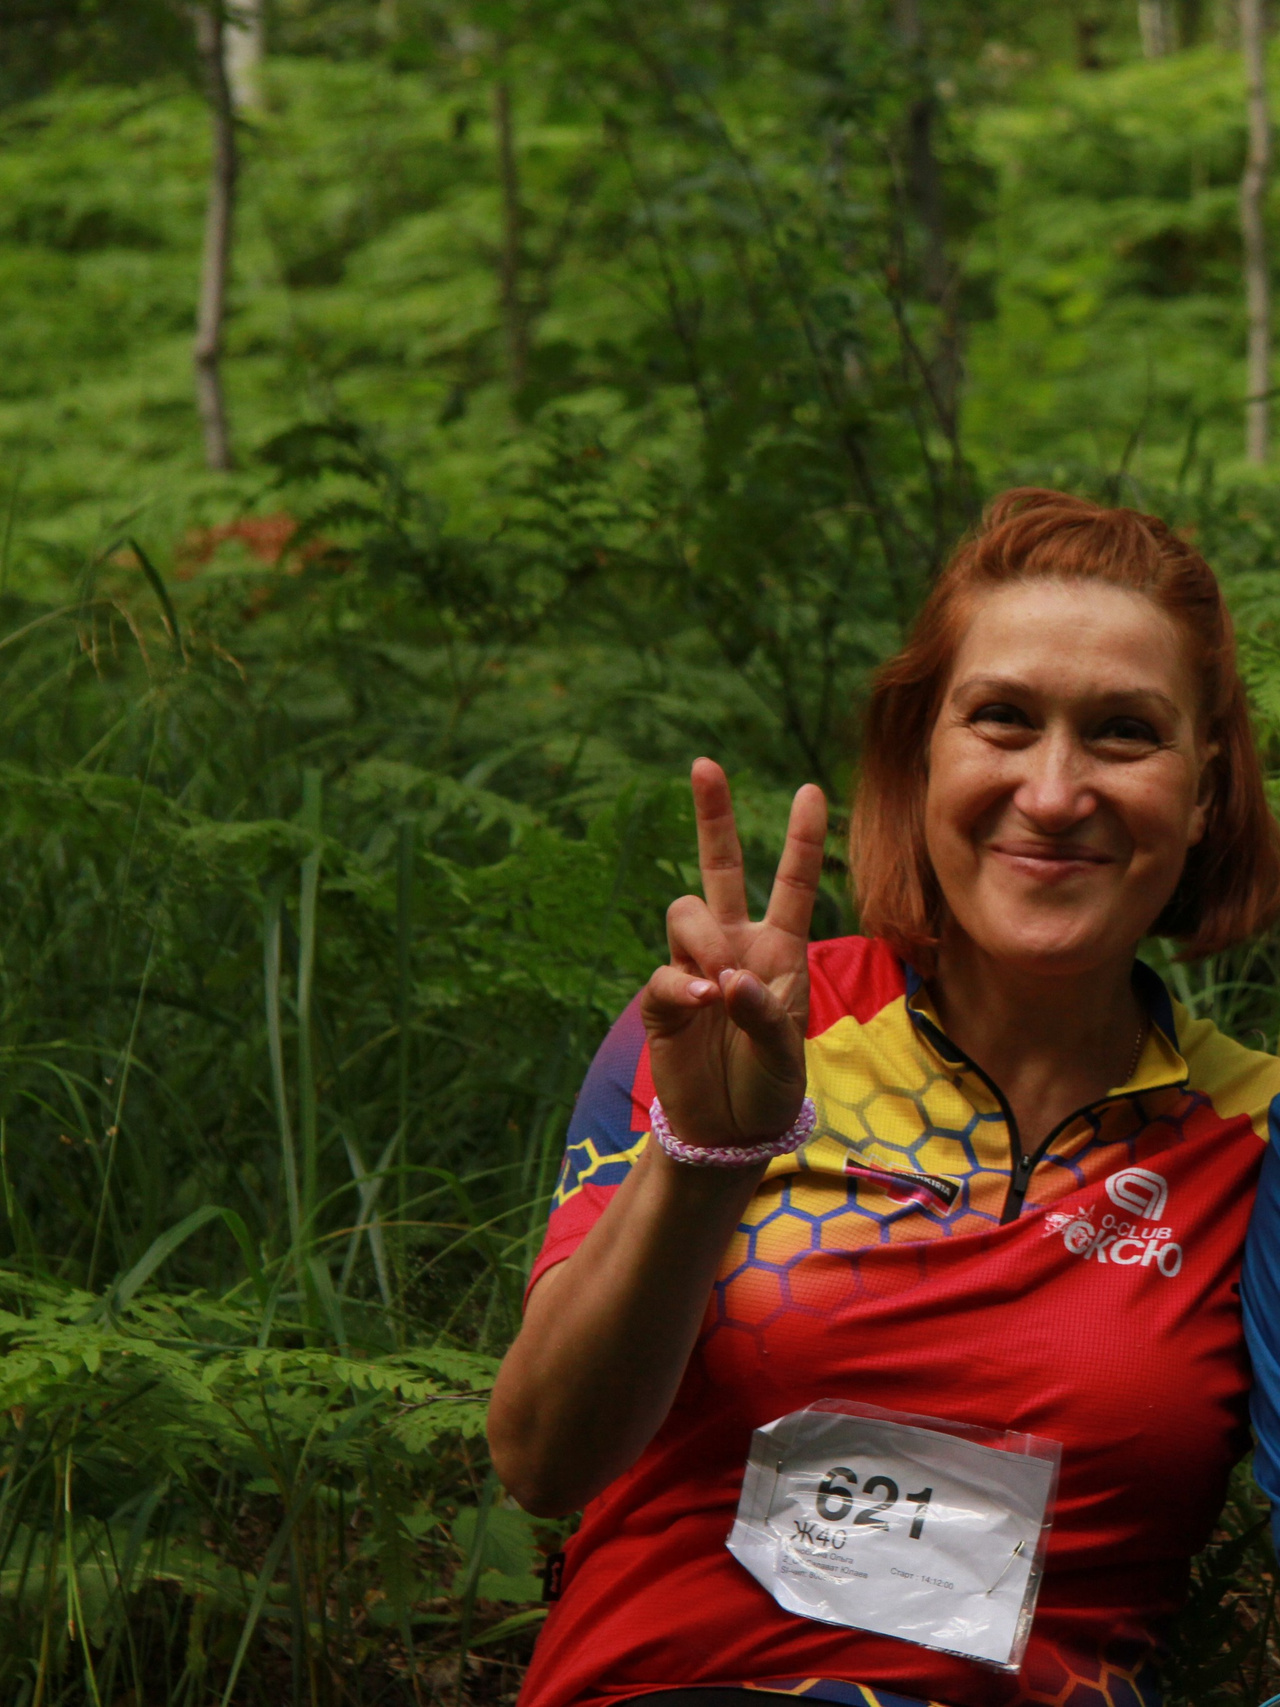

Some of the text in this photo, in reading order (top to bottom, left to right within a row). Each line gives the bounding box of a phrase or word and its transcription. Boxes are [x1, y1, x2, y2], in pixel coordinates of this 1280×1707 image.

[1102, 1214, 1173, 1239] O-CLUB
[816, 1466, 933, 1540] 621
[790, 1520, 847, 1550] Ж40
[890, 1567, 914, 1579] Старт
[921, 1575, 954, 1590] 14:12:00
